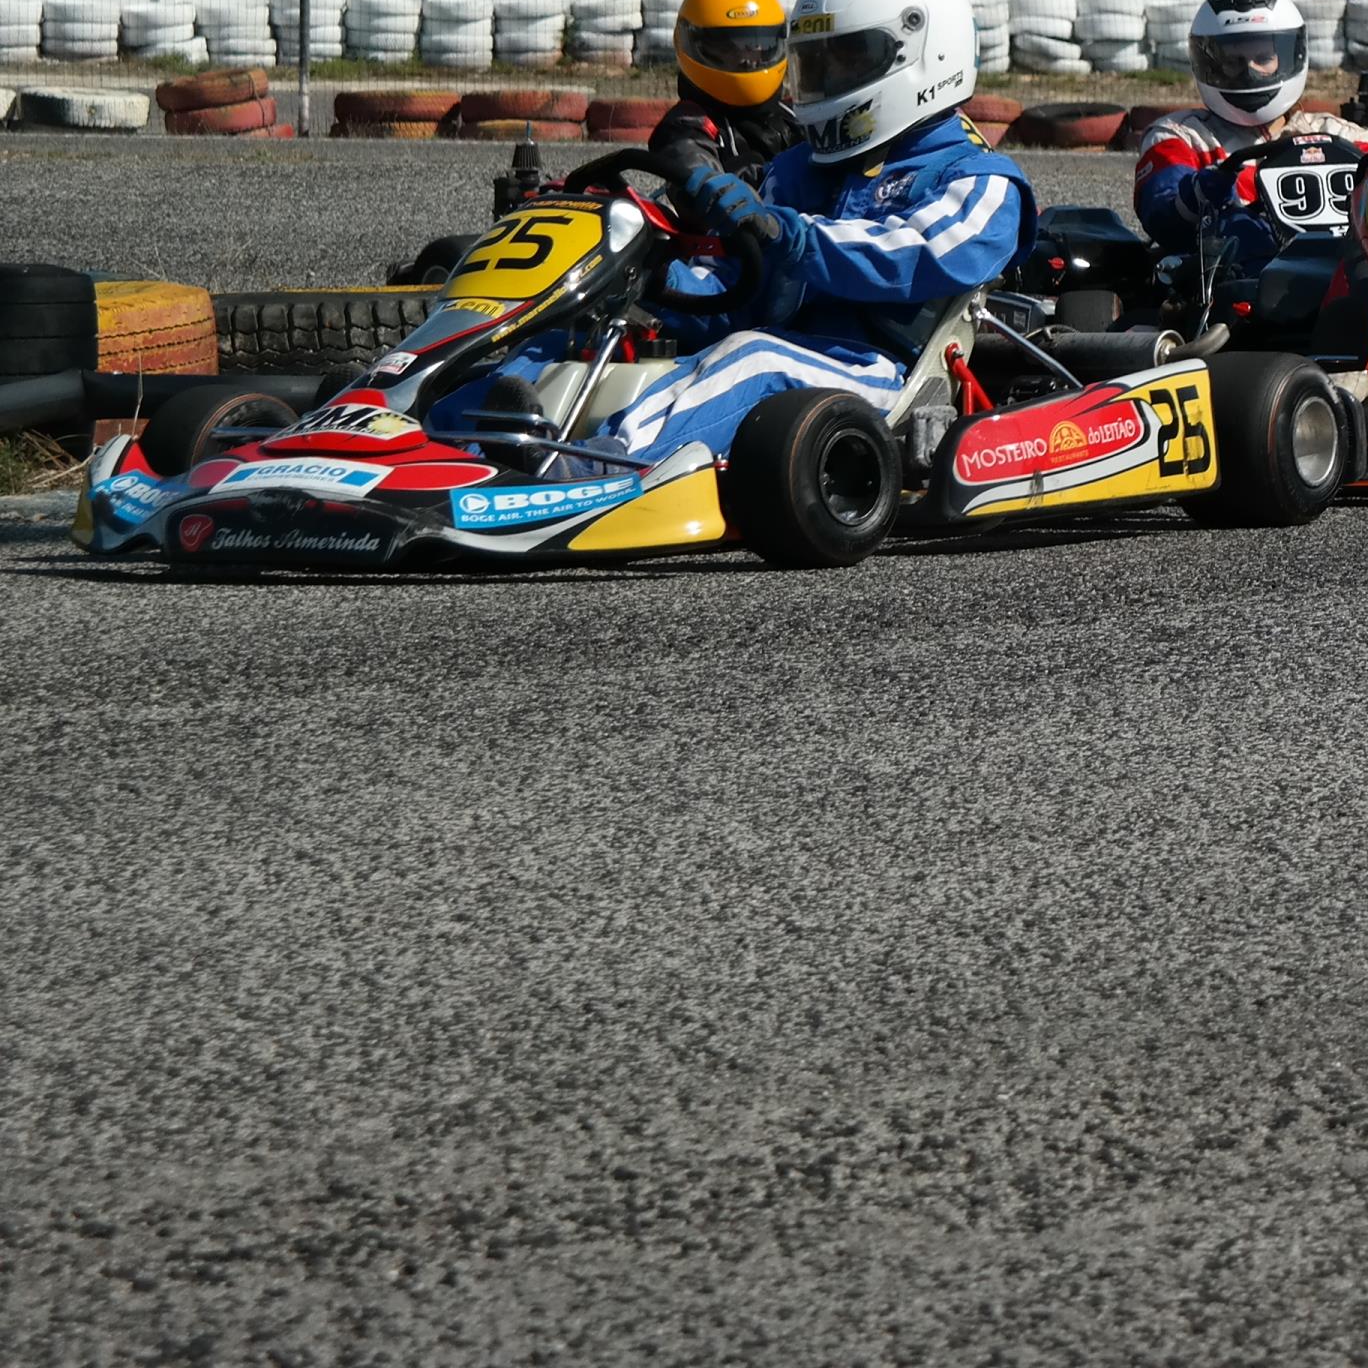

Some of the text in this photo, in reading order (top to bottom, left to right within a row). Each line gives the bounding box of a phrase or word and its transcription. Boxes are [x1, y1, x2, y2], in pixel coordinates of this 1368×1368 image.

[802, 14, 832, 32] eni
[917, 84, 936, 106] K1
[1276, 166, 1359, 222] 99
[450, 215, 575, 279] 25
[1149, 384, 1211, 478] 25
[961, 437, 1048, 478] MOSTEIRO
[461, 513, 496, 523] BOGE
[525, 508, 550, 518] THE
[552, 503, 574, 514] AIR
[576, 499, 593, 508] TO
[493, 477, 634, 511] BOGE
[211, 527, 271, 550] Talhos
